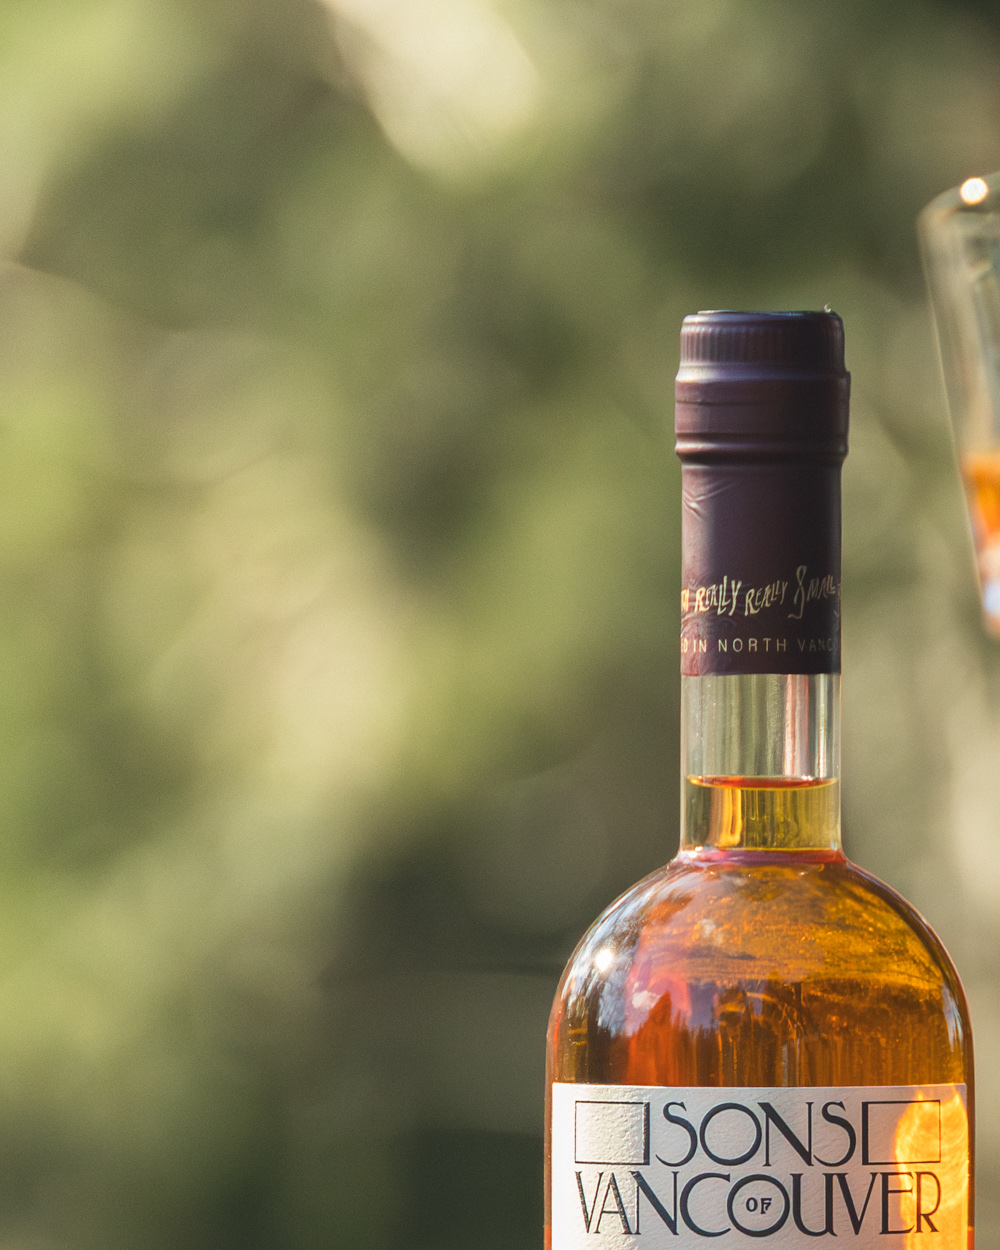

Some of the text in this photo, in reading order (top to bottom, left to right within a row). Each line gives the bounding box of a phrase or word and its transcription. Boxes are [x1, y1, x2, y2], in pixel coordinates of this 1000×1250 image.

[718, 637, 787, 652] NORTH
[655, 1100, 856, 1167] SONS
[574, 1170, 942, 1238] VANCOUVER
[745, 1196, 773, 1215] OF
